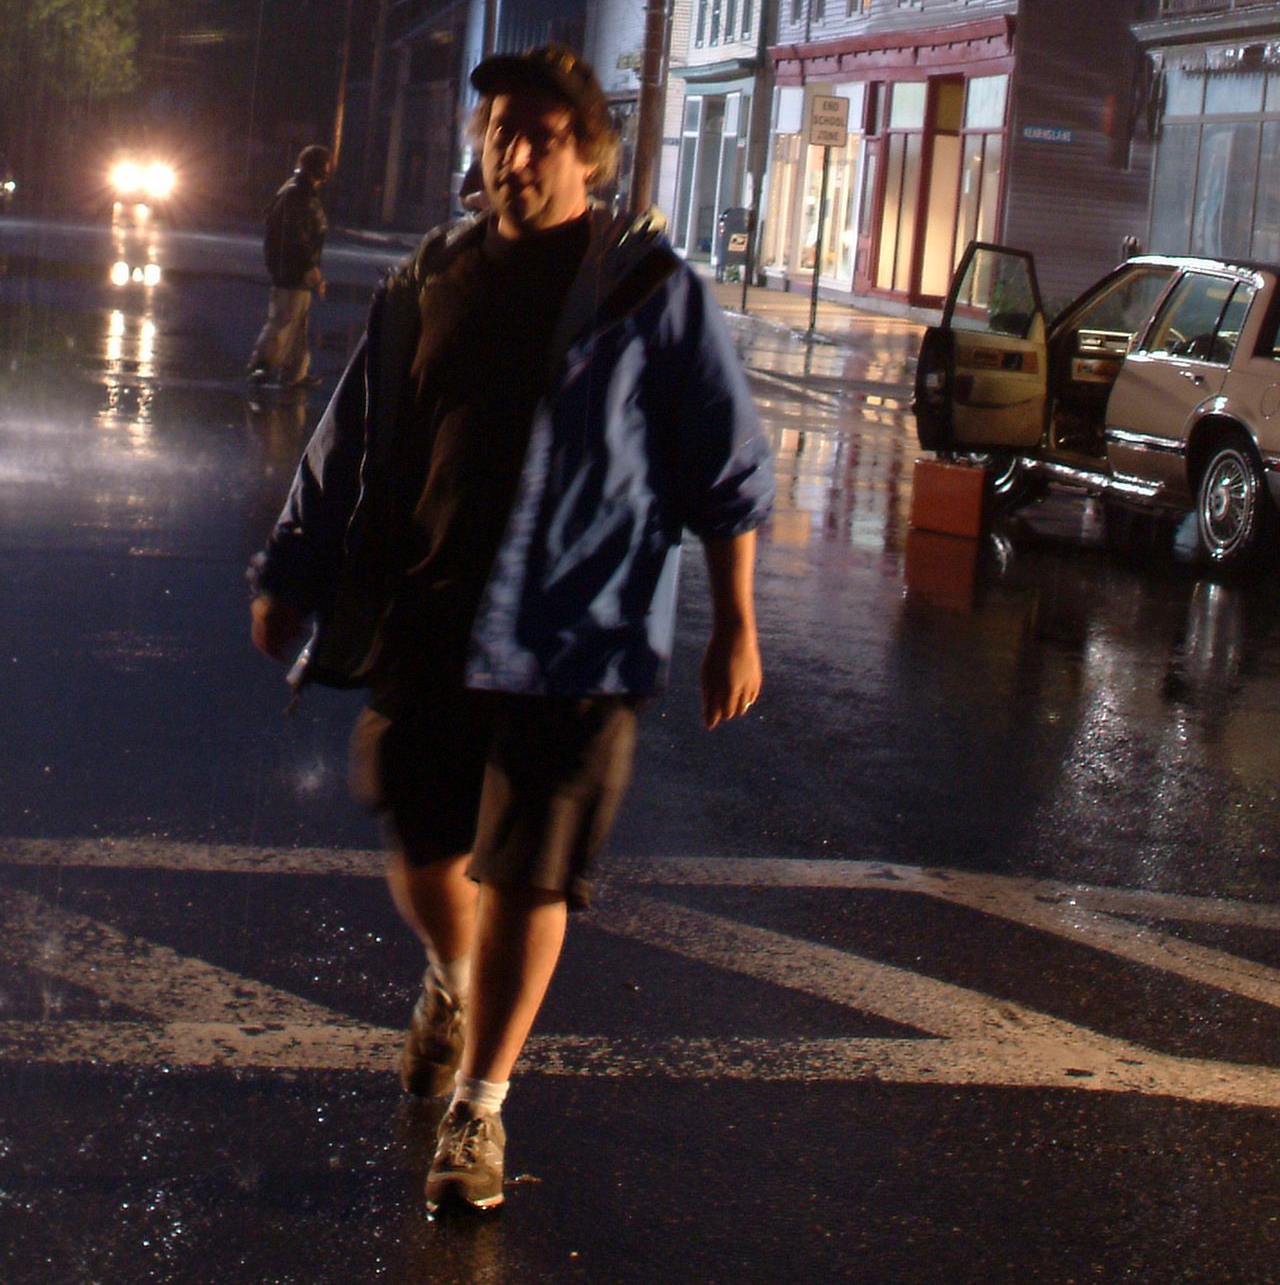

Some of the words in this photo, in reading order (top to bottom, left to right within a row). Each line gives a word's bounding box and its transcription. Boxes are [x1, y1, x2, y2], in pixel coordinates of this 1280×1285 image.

[823, 100, 839, 111] END
[813, 115, 845, 127] SCHOOL
[818, 130, 839, 141] ZONE
